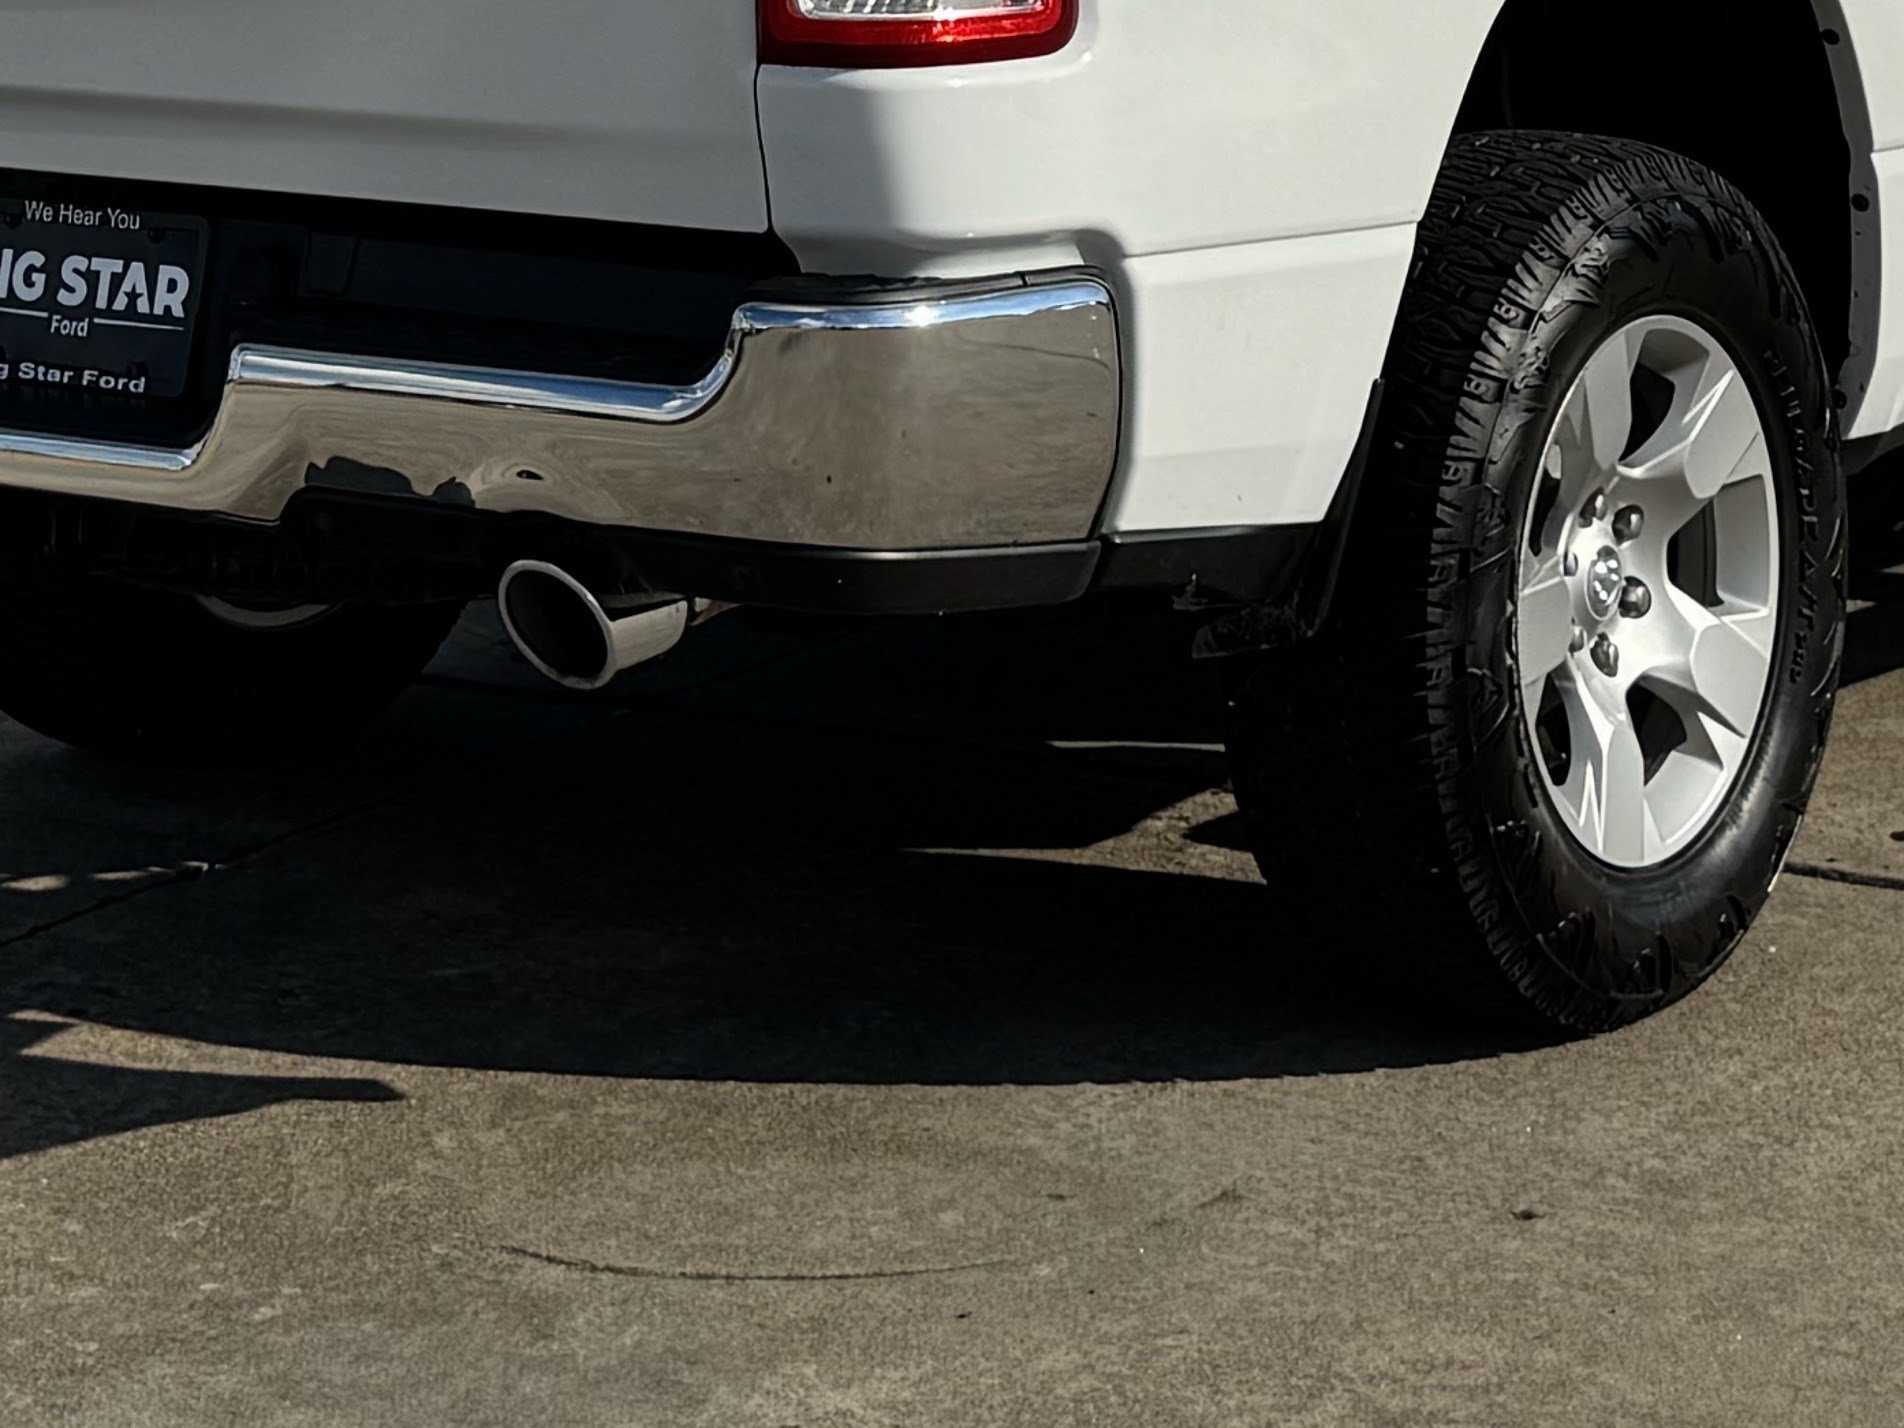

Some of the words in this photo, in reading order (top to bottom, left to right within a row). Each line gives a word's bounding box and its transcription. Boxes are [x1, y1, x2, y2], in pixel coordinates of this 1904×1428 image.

[24, 200, 54, 223] We
[58, 203, 102, 227] Hear
[106, 207, 140, 231] You
[56, 255, 191, 318] STAR
[50, 315, 89, 338] Ford
[18, 361, 75, 385] Star
[82, 369, 146, 394] Ford
